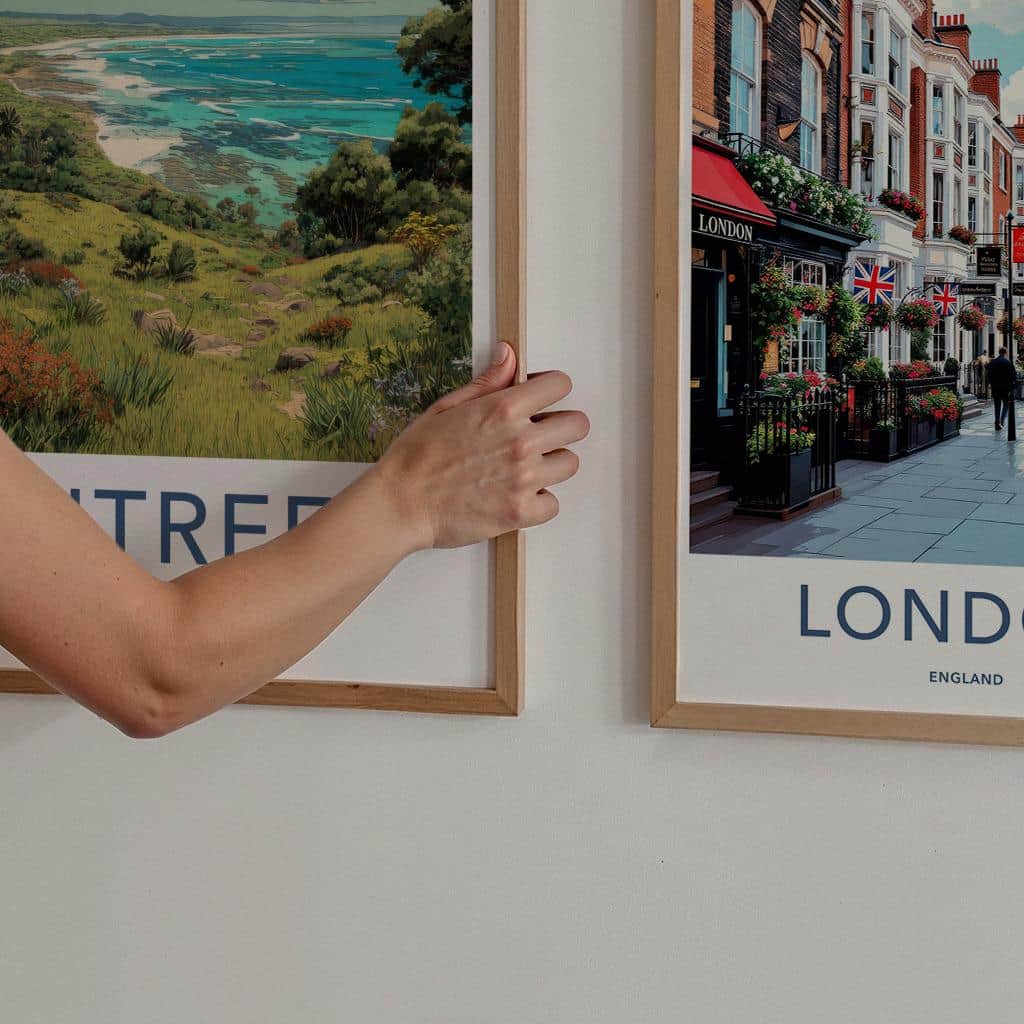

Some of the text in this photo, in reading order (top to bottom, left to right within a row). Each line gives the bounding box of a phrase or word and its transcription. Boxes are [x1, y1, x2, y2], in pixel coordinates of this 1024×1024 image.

[699, 213, 753, 242] LONDON
[800, 584, 1024, 645] LOND
[929, 671, 1004, 686] ENGLAND
